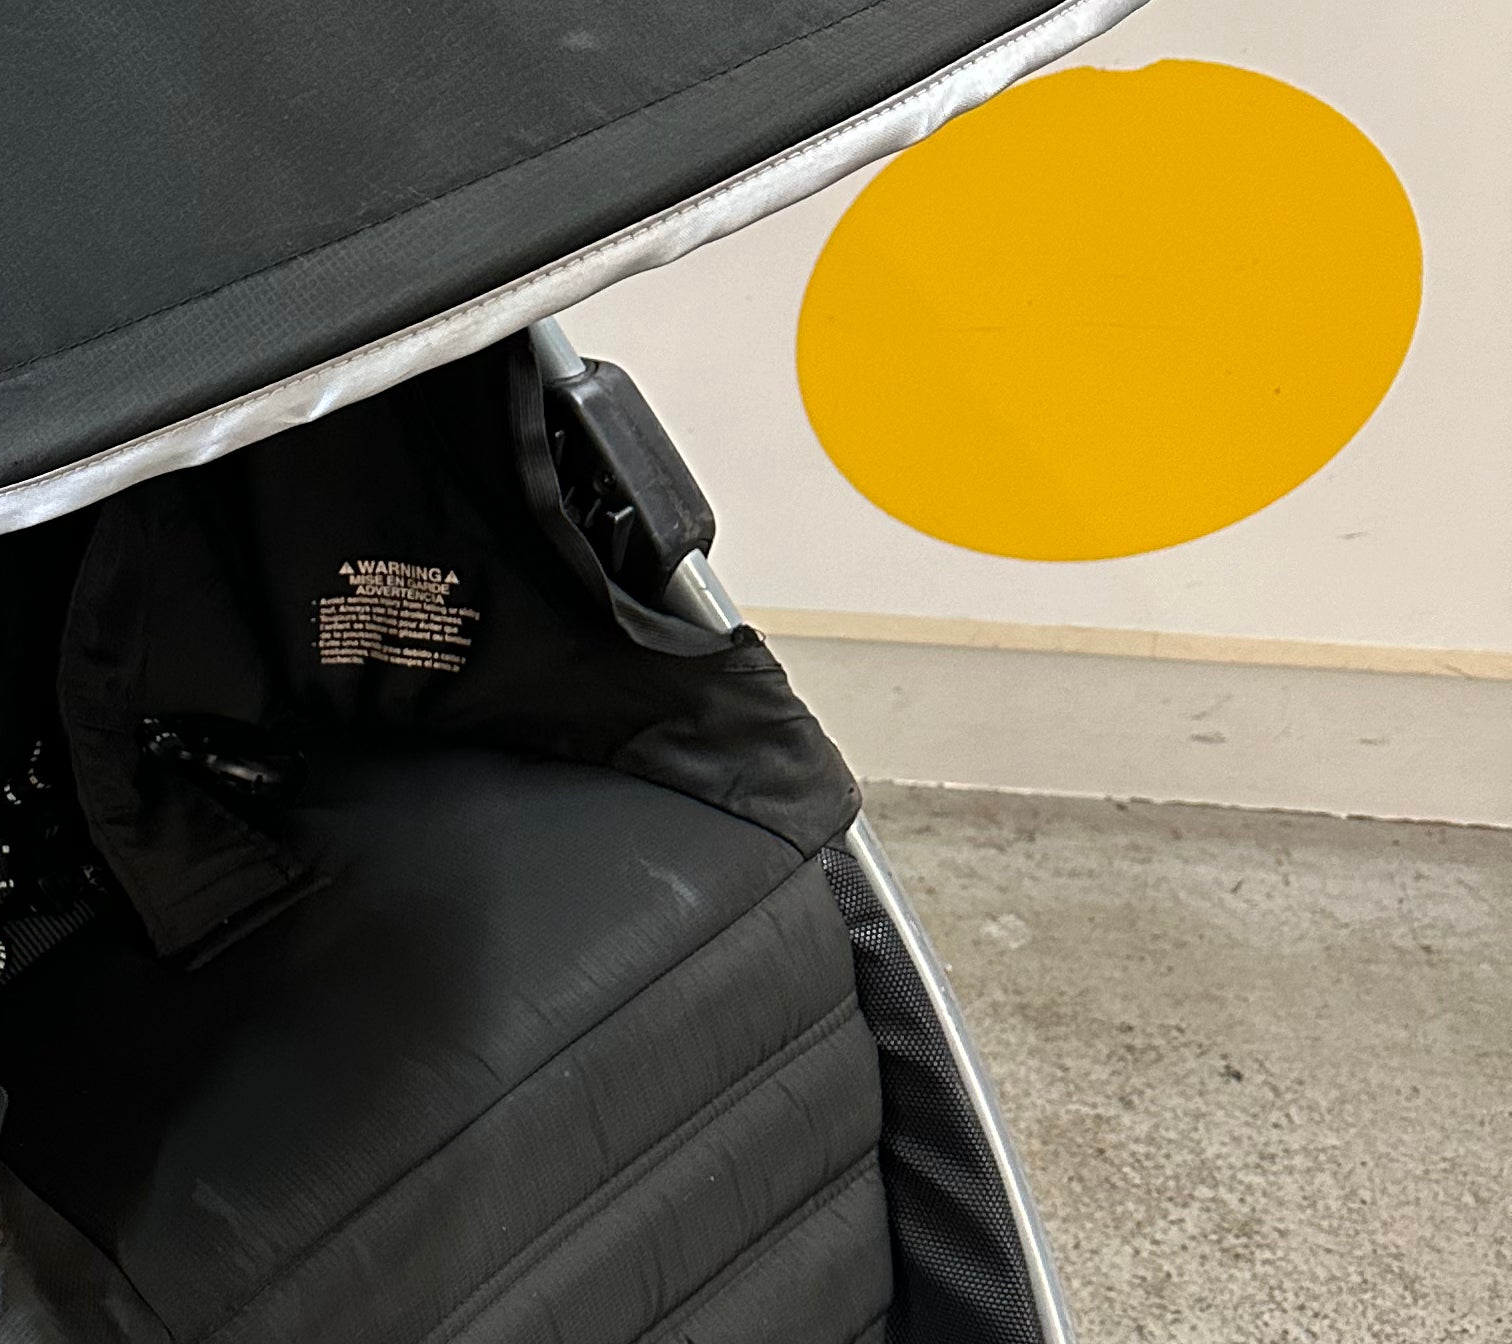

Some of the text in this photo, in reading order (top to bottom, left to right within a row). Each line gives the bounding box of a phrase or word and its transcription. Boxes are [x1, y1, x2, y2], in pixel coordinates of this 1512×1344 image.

[356, 560, 442, 582] WARNING
[349, 575, 450, 595] MISE EN GARDE
[355, 585, 445, 605] ADVERTENCIA
